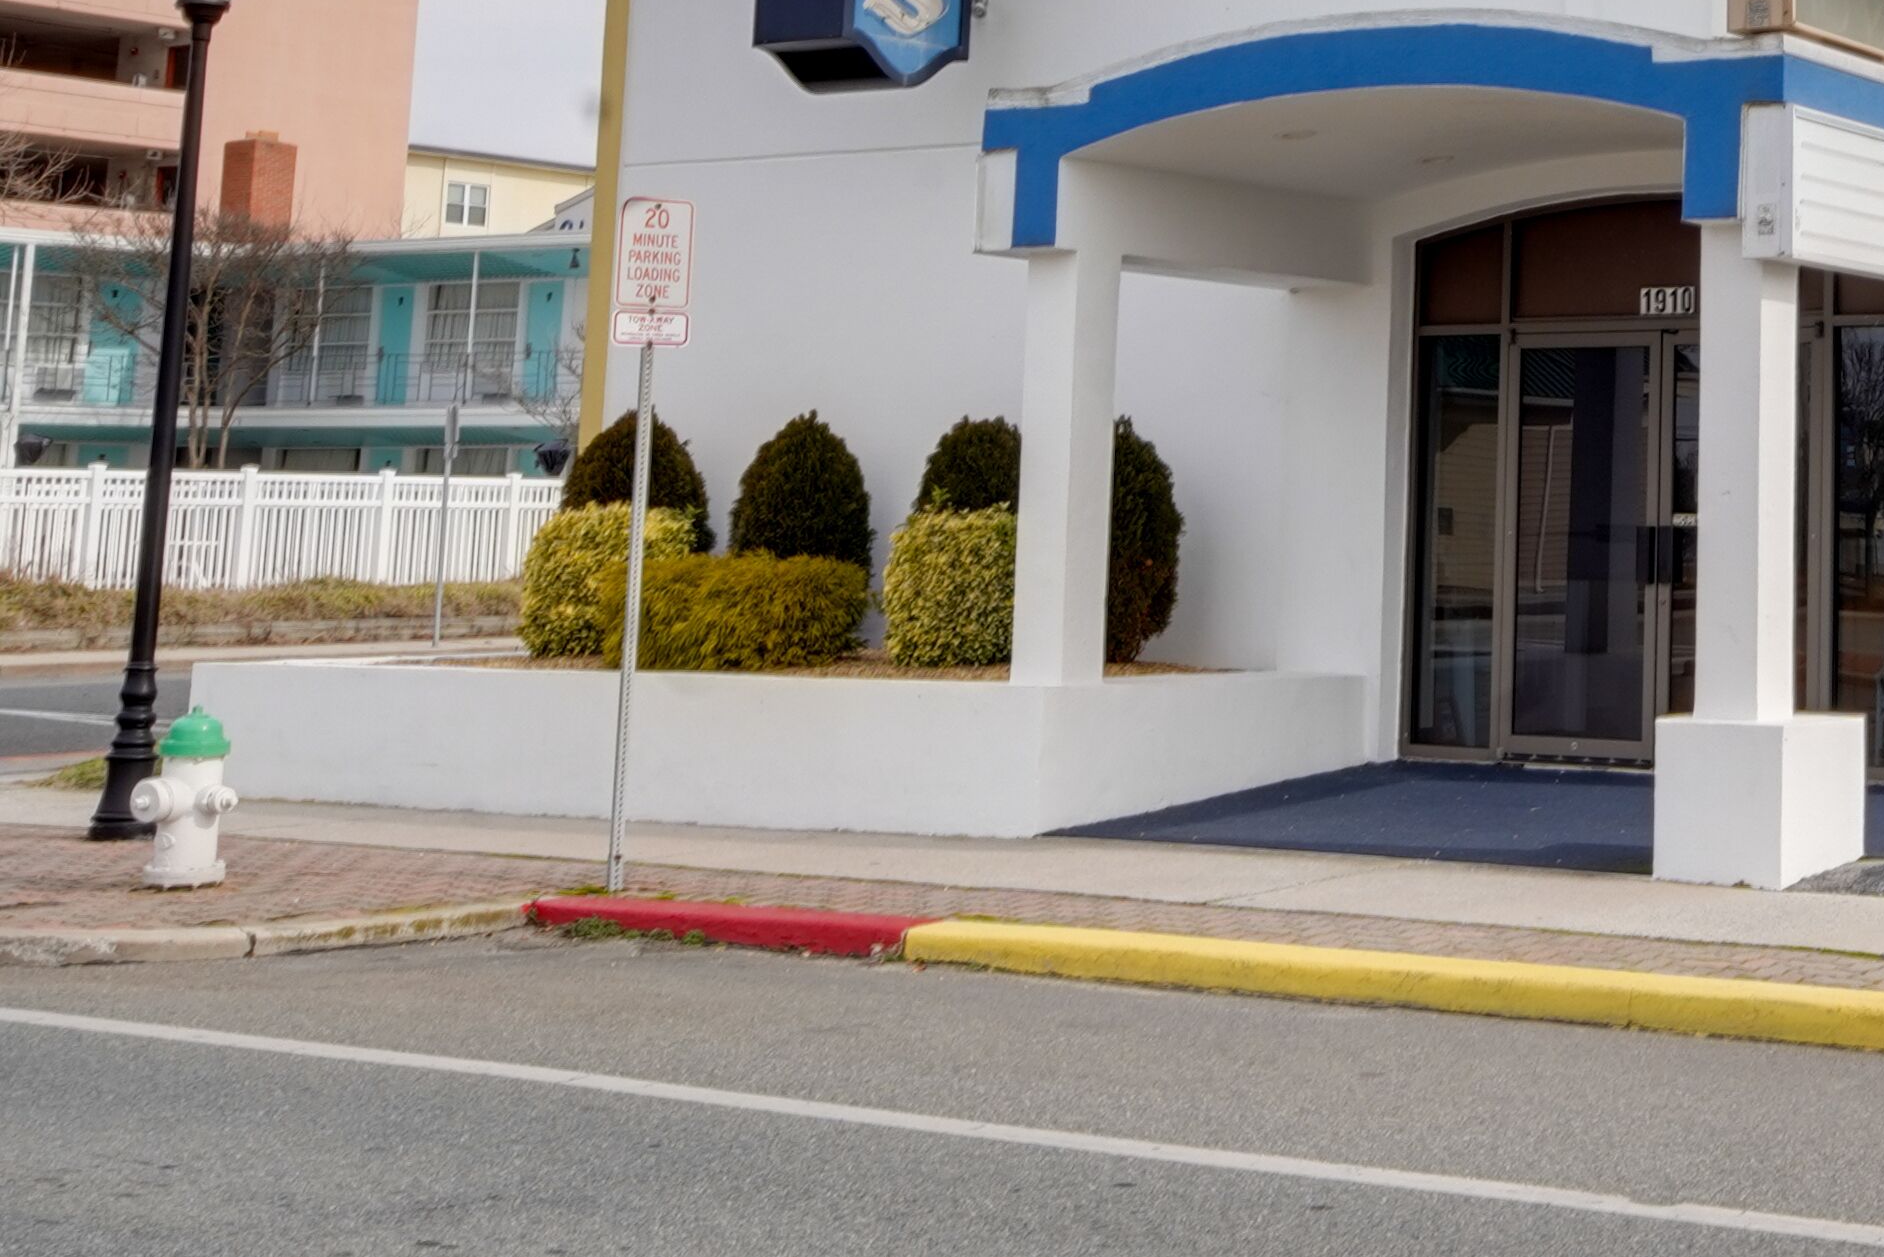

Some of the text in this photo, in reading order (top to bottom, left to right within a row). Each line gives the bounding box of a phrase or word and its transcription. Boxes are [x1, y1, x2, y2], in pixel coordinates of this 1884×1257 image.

[644, 208, 670, 229] 20
[632, 233, 679, 248] MINUTE
[628, 250, 681, 266] PARKING
[626, 267, 681, 283] LOADING
[635, 284, 670, 299] ZONE
[1642, 288, 1692, 313] 1910
[638, 324, 663, 332] ZONE
